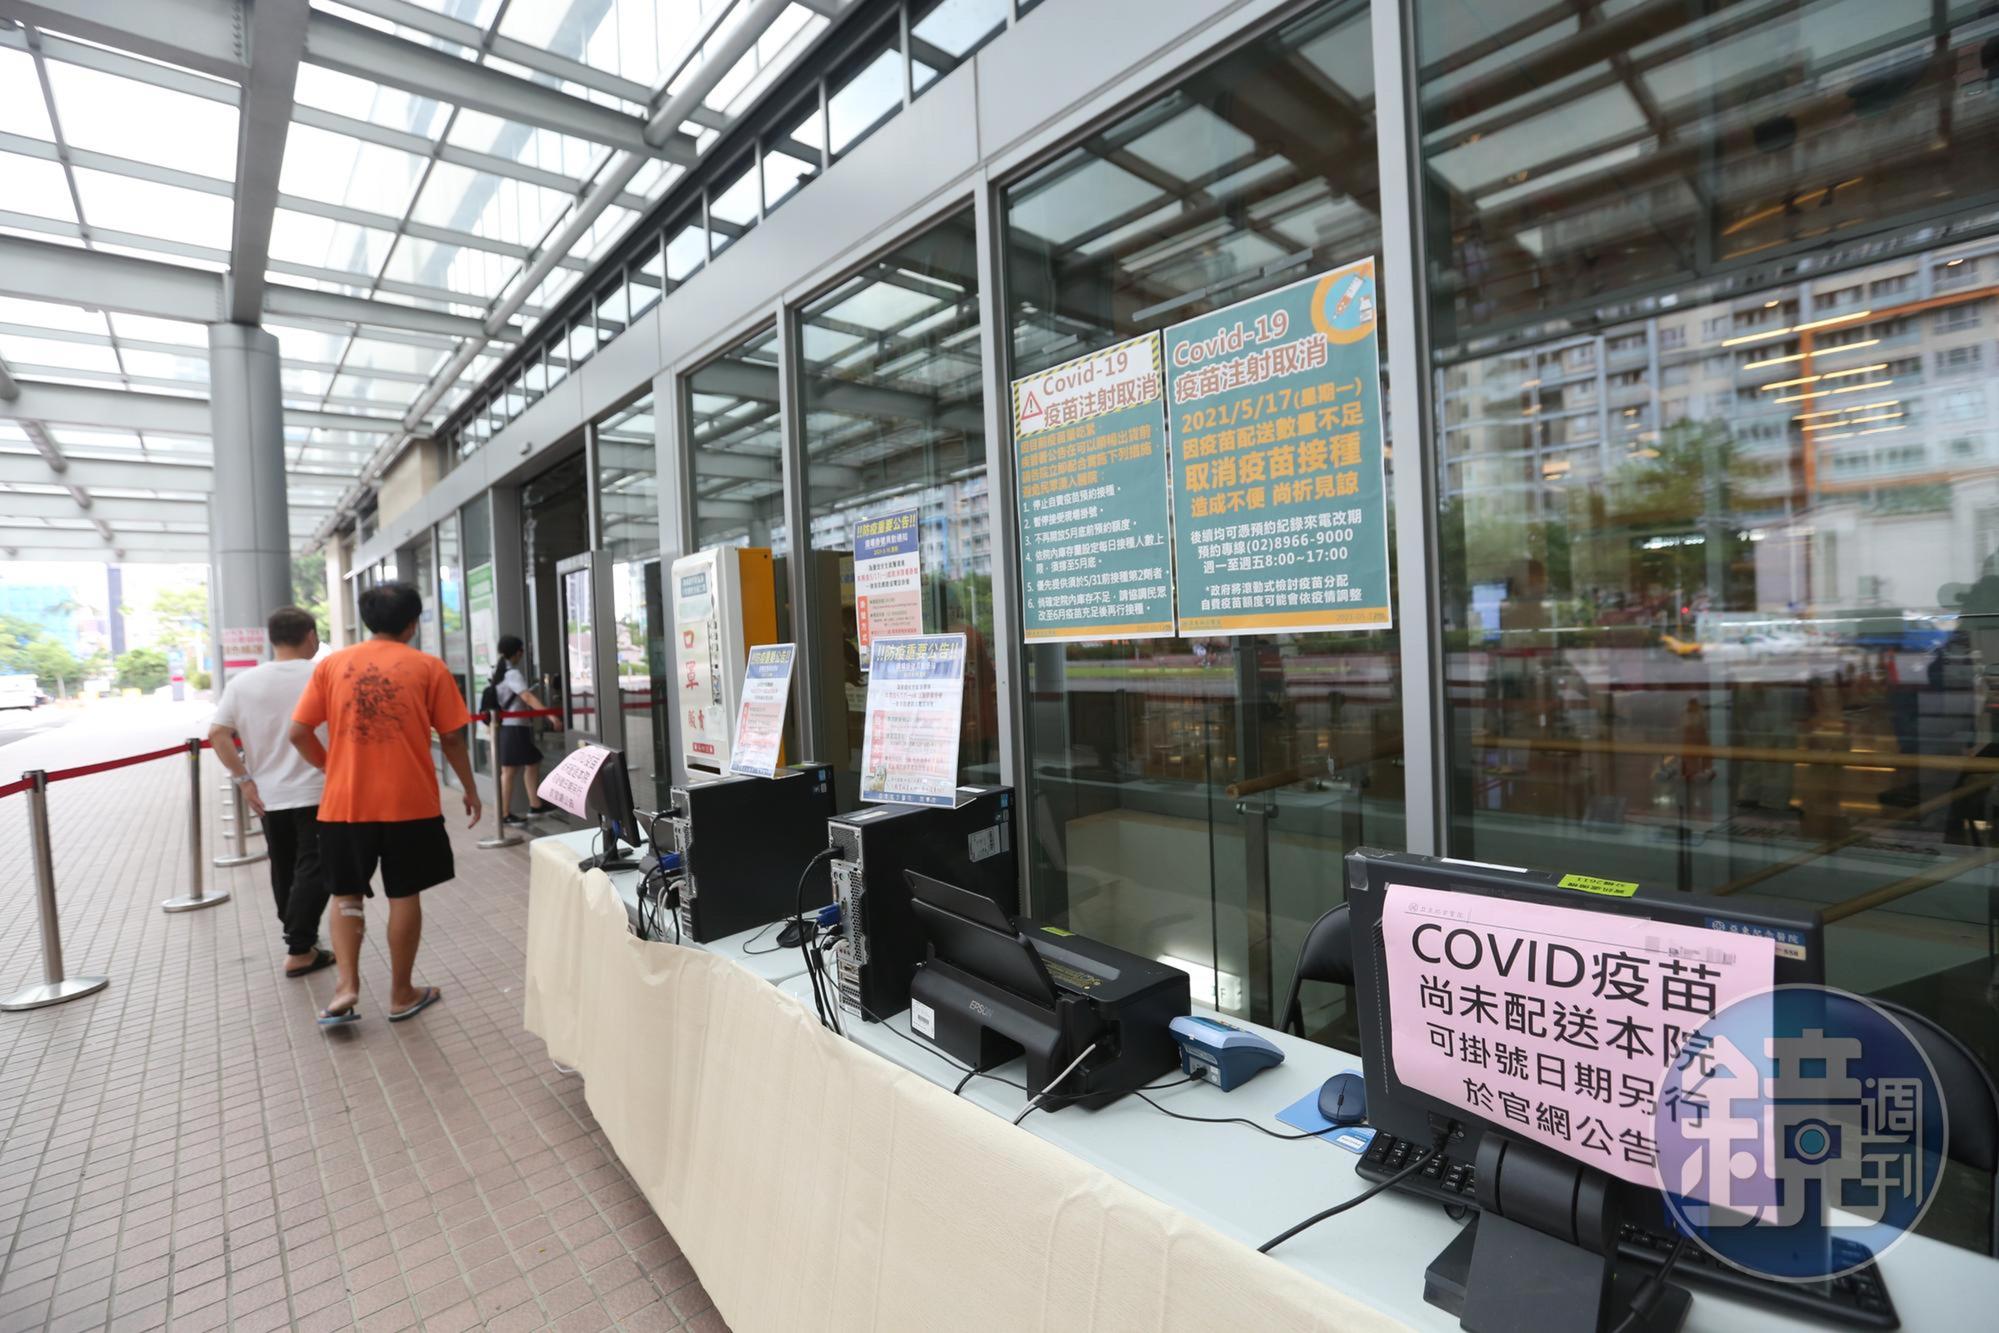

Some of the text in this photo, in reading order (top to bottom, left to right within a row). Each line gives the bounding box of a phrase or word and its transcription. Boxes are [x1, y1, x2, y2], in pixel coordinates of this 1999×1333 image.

[1174, 311, 1289, 366] Covid-19
[1175, 335, 1327, 402] 疫苗注射取消
[1043, 351, 1128, 396] Covid-19
[1044, 373, 1157, 427] 疫苗注射取消
[1183, 402, 1364, 460] 因疫苗配送數量不足
[1185, 431, 1362, 492] 取消疫苗接種
[1191, 486, 1265, 518] 造成不便
[1411, 923, 1721, 1020] COVID疫苗
[1420, 974, 1717, 1077] 尚未配送本院
[1426, 1021, 1710, 1129] 可掛號日期另行
[1462, 1077, 1662, 1169] 於官網公告
